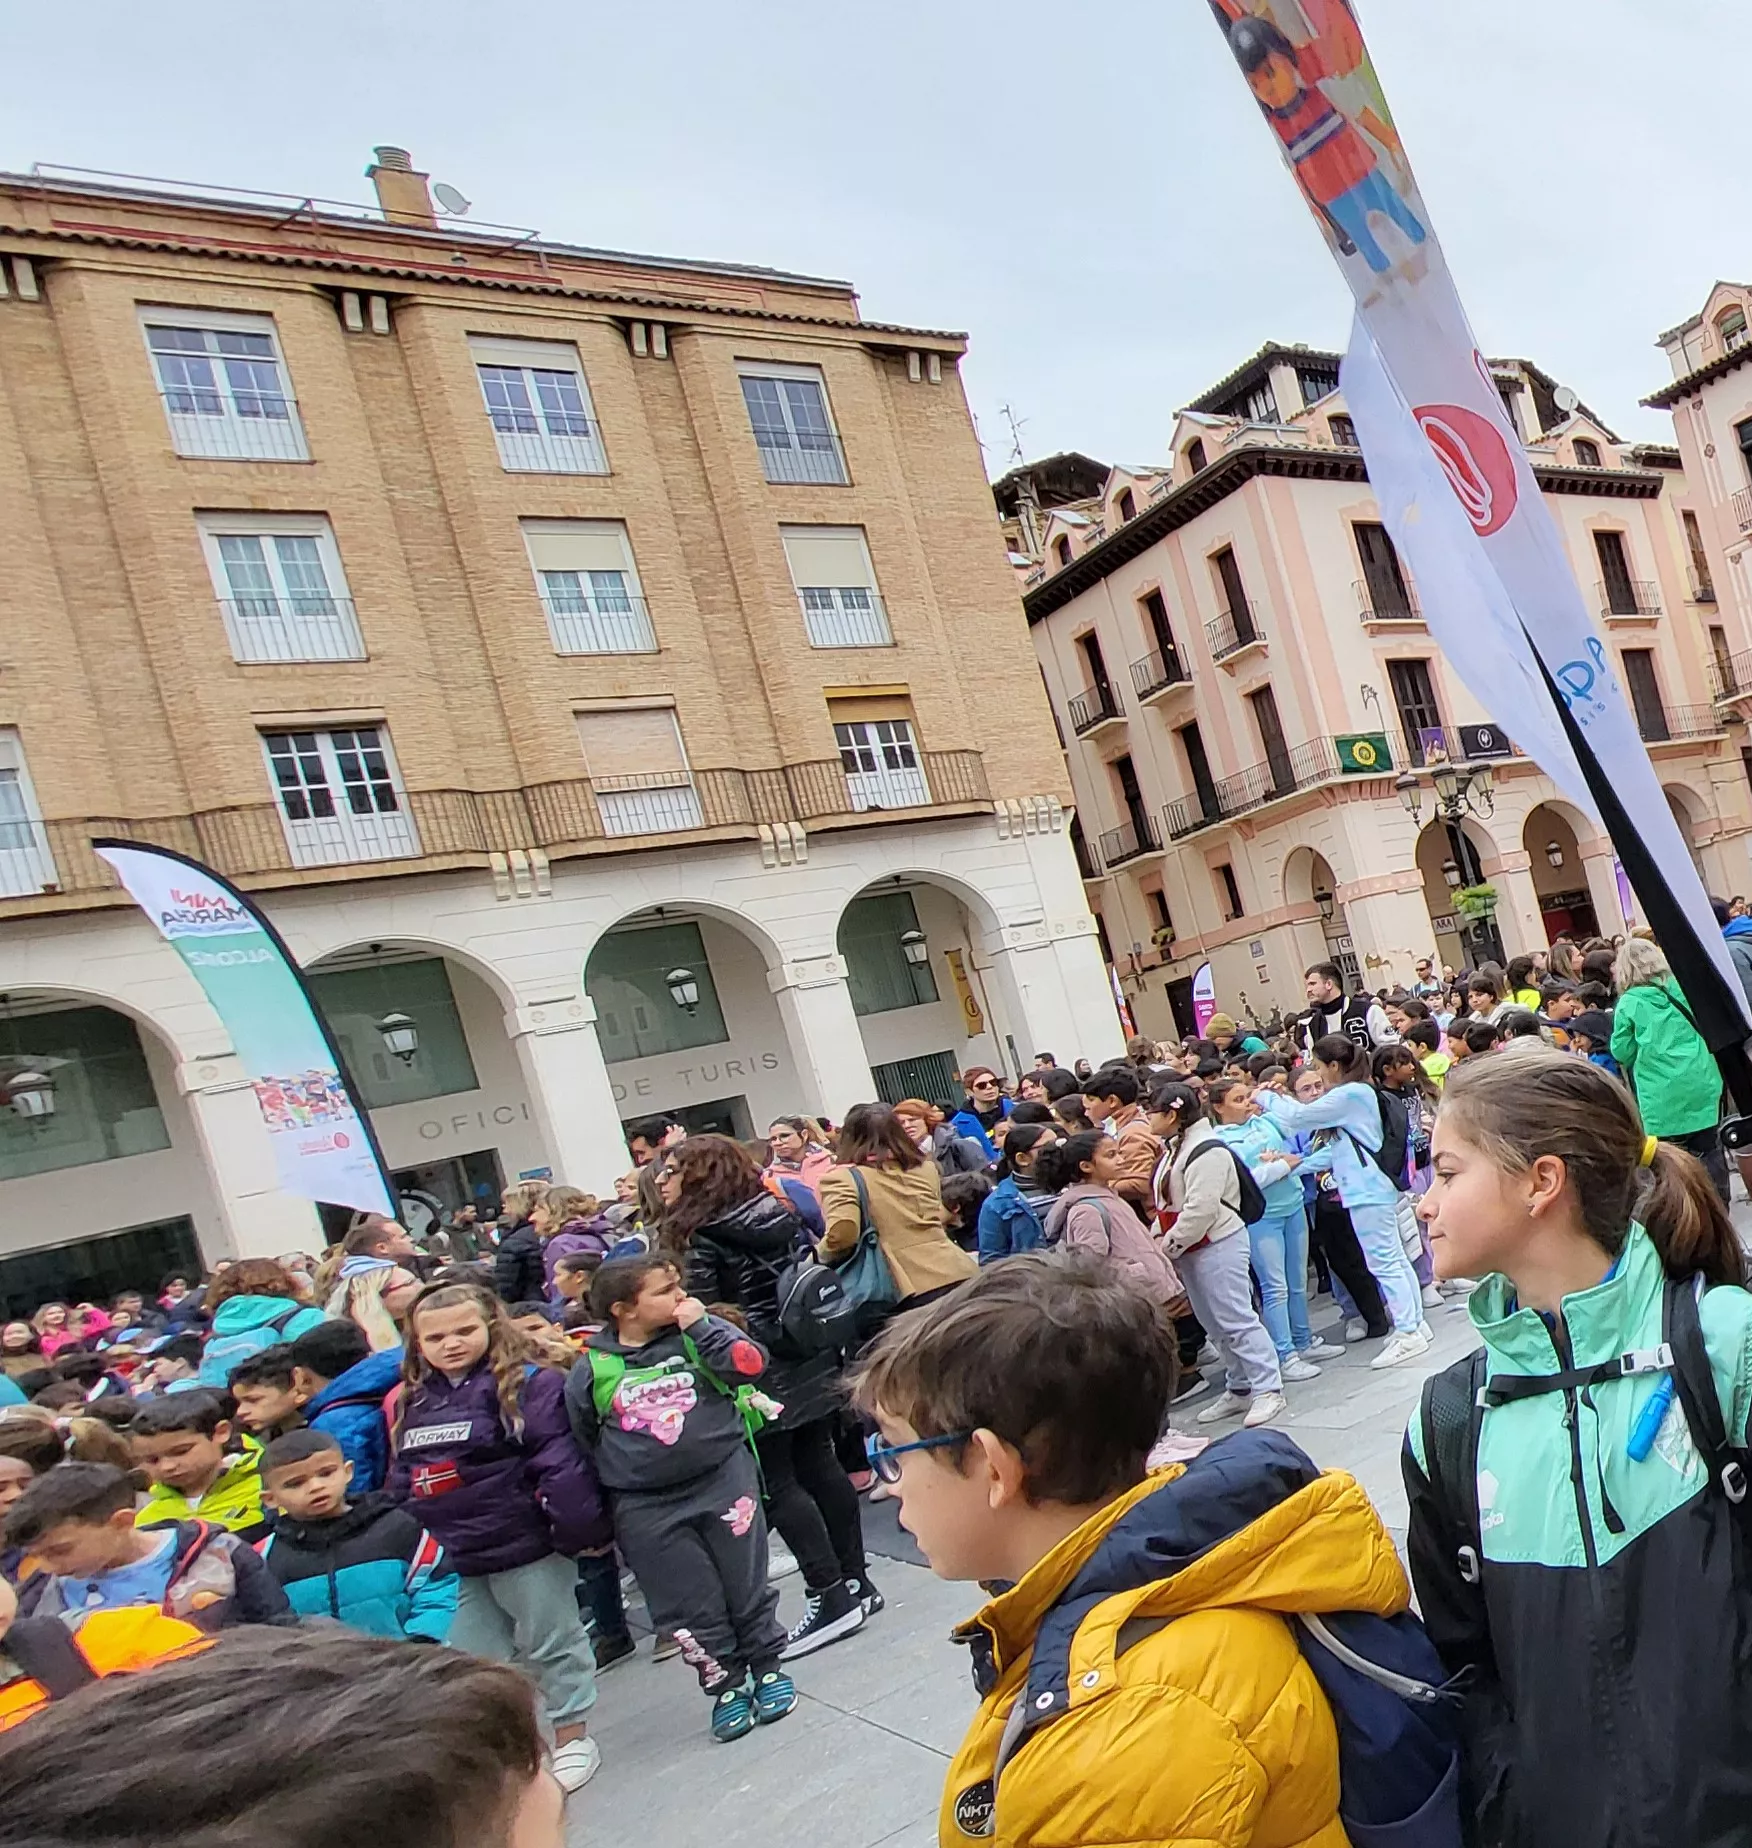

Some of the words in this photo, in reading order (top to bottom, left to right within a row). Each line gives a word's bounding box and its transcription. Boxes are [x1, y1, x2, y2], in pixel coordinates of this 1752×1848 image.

[418, 1101, 531, 1141] OFICI
[676, 1051, 781, 1088] TURIS
[407, 1429, 467, 1447] NORWAY
[958, 1802, 992, 1819] NXT
